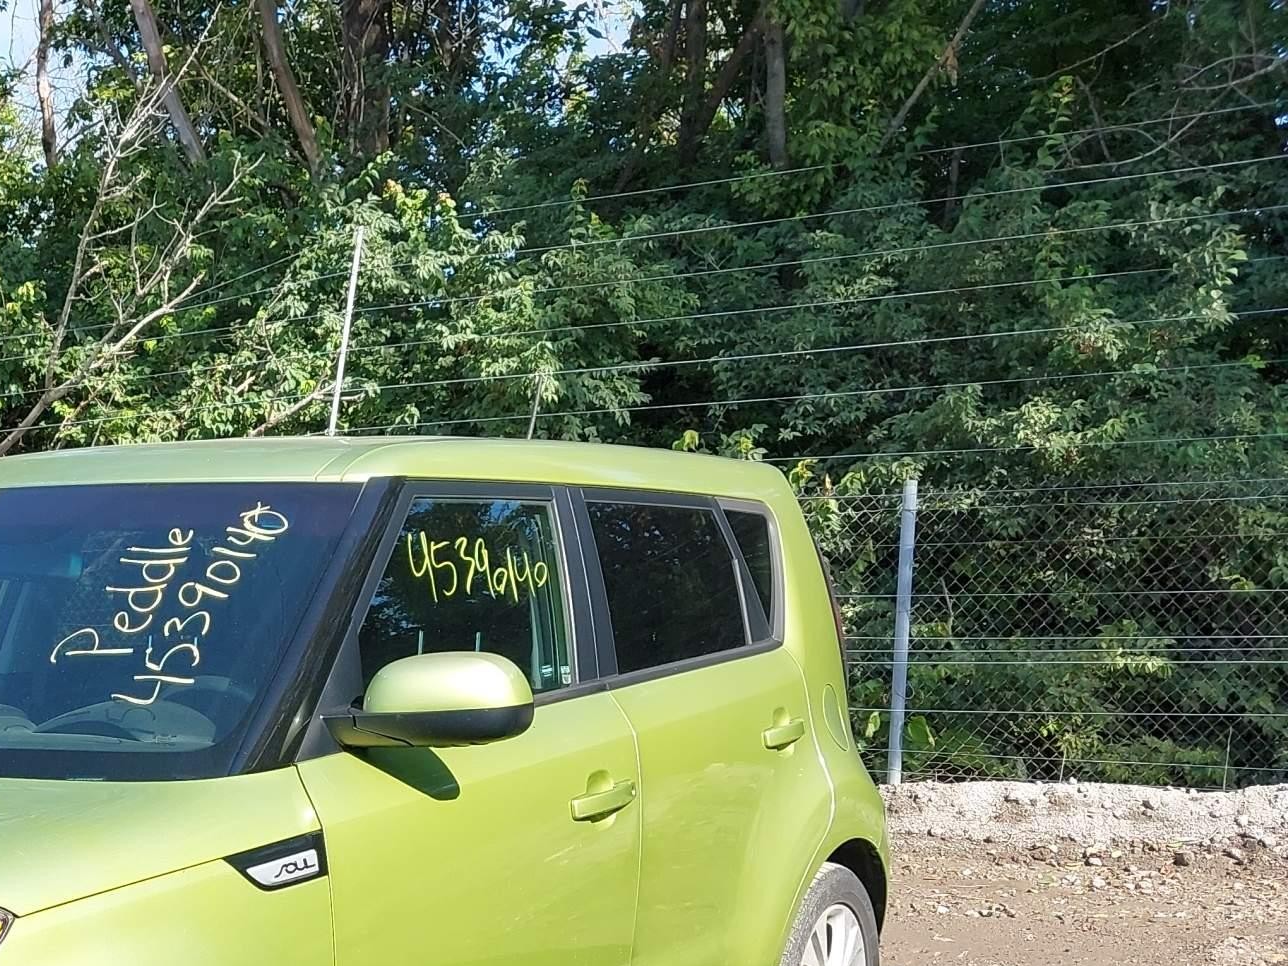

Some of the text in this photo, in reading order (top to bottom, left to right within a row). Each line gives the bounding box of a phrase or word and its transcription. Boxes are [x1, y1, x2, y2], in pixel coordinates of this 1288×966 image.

[50, 527, 194, 663] Peddle
[110, 505, 289, 705] 45390140
[274, 858, 316, 878] SOUL
